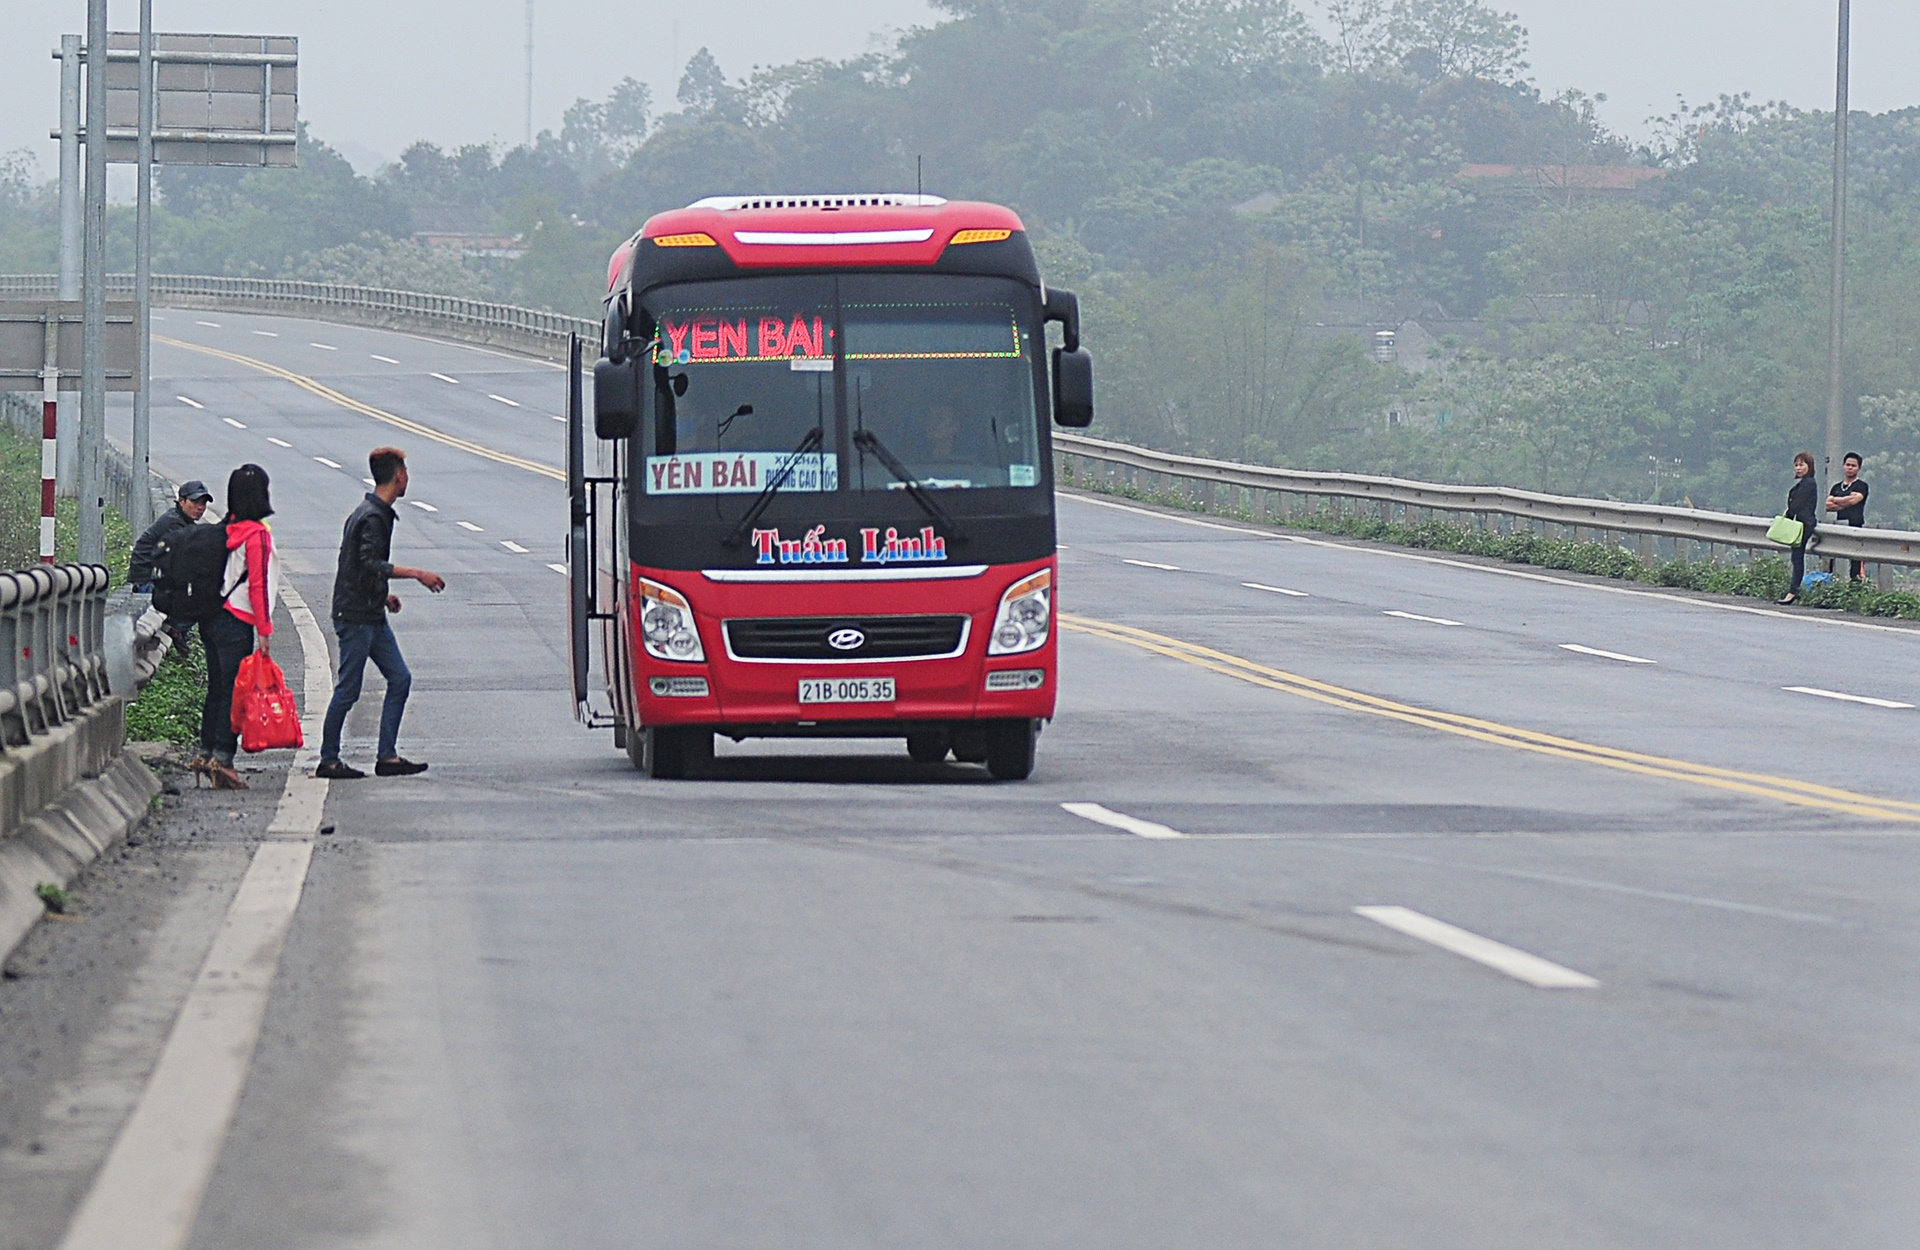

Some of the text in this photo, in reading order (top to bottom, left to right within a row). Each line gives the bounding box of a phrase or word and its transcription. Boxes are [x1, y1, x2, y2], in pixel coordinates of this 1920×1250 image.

[651, 454, 757, 490] YÊN BÁI
[799, 470, 818, 488] CAO
[822, 465, 837, 489] ỐC
[752, 524, 948, 565] Tuấn Linh
